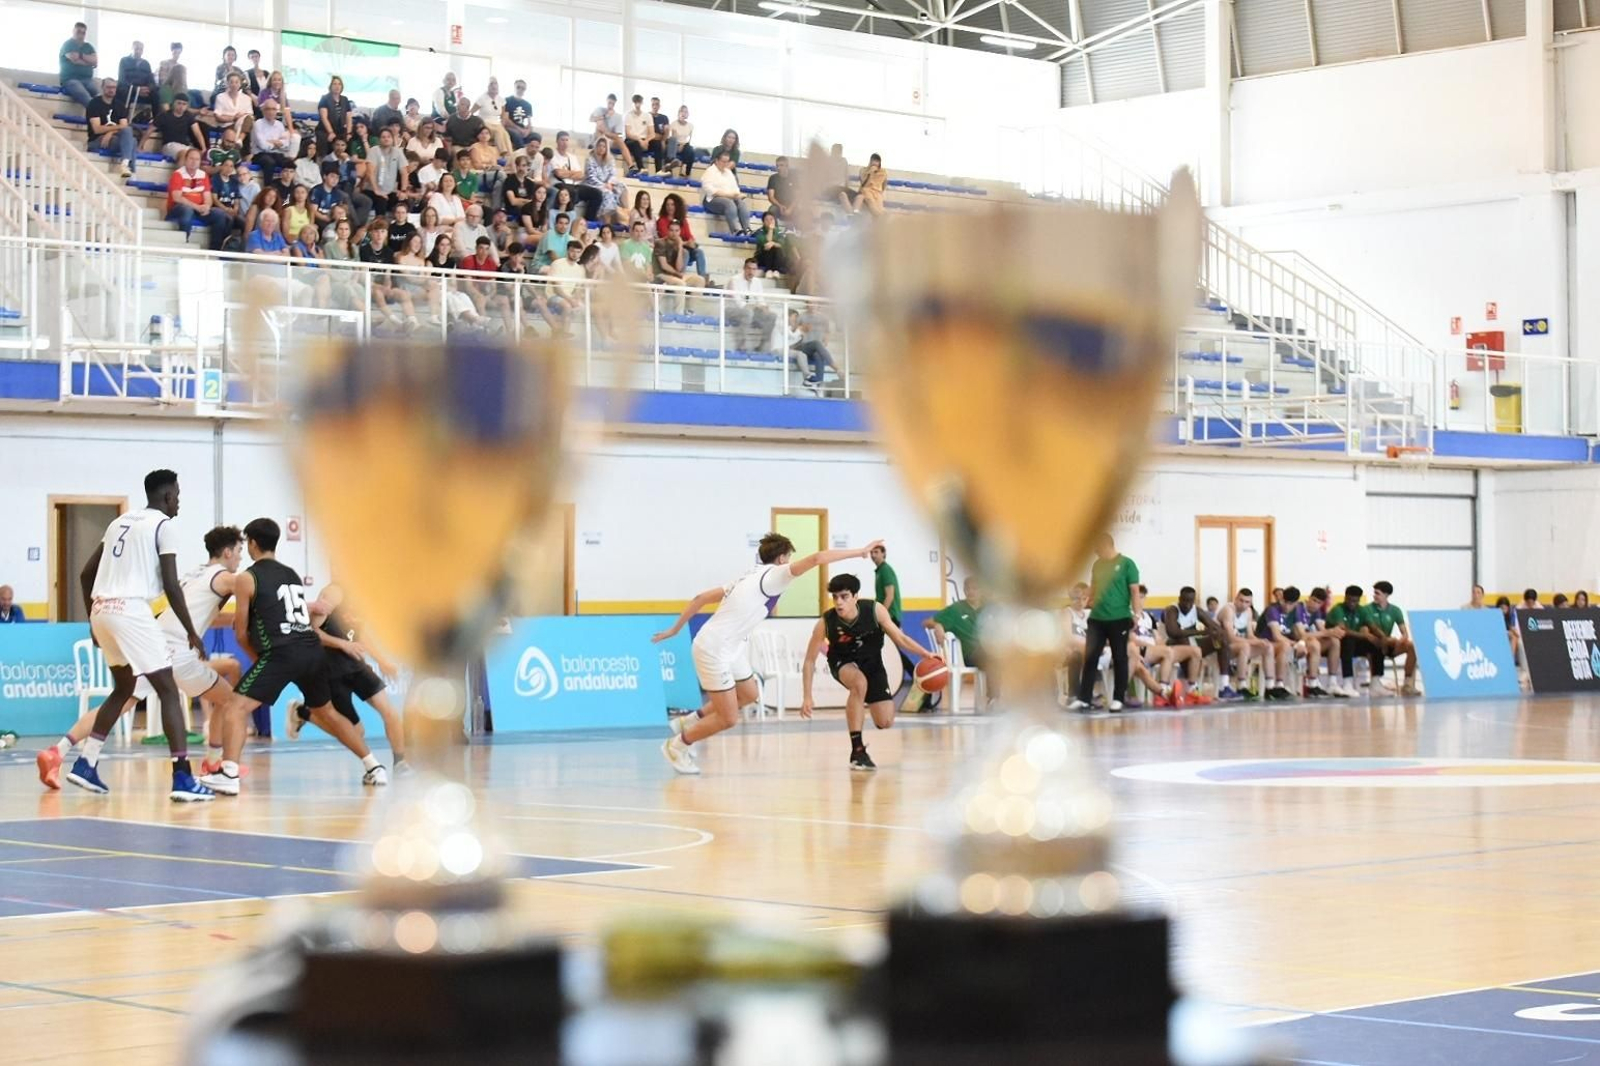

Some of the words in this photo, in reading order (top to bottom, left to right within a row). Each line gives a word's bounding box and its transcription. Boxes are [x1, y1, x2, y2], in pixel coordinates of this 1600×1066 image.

[205, 379, 218, 399] 2
[112, 525, 131, 558] 3
[277, 584, 310, 626] 15
[0, 660, 90, 680] balonceso
[561, 653, 640, 673] baloncesto
